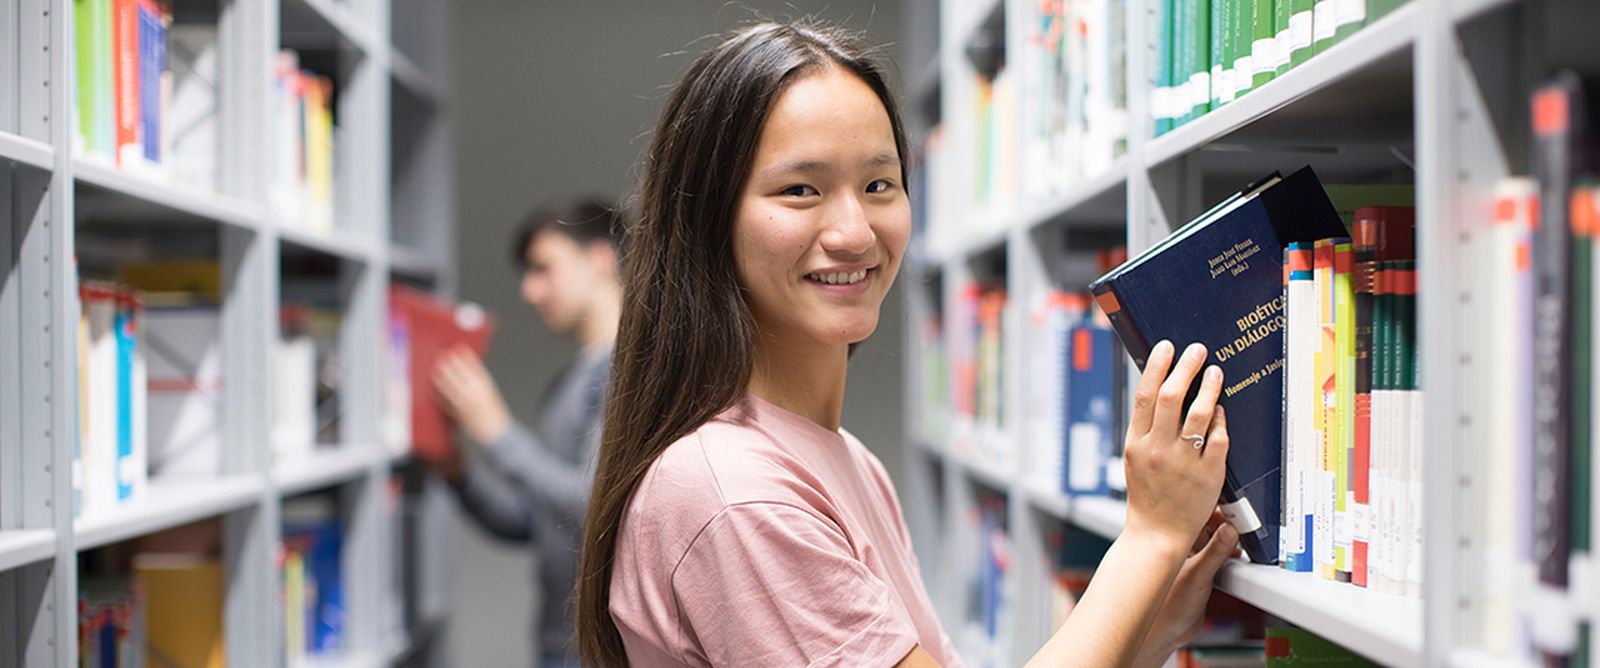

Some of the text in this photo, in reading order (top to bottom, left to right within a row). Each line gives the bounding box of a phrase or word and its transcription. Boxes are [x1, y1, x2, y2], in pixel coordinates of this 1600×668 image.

[1215, 315, 1284, 362] UN DIÁLOGO
[1225, 359, 1284, 397] Homenaje a Javie
